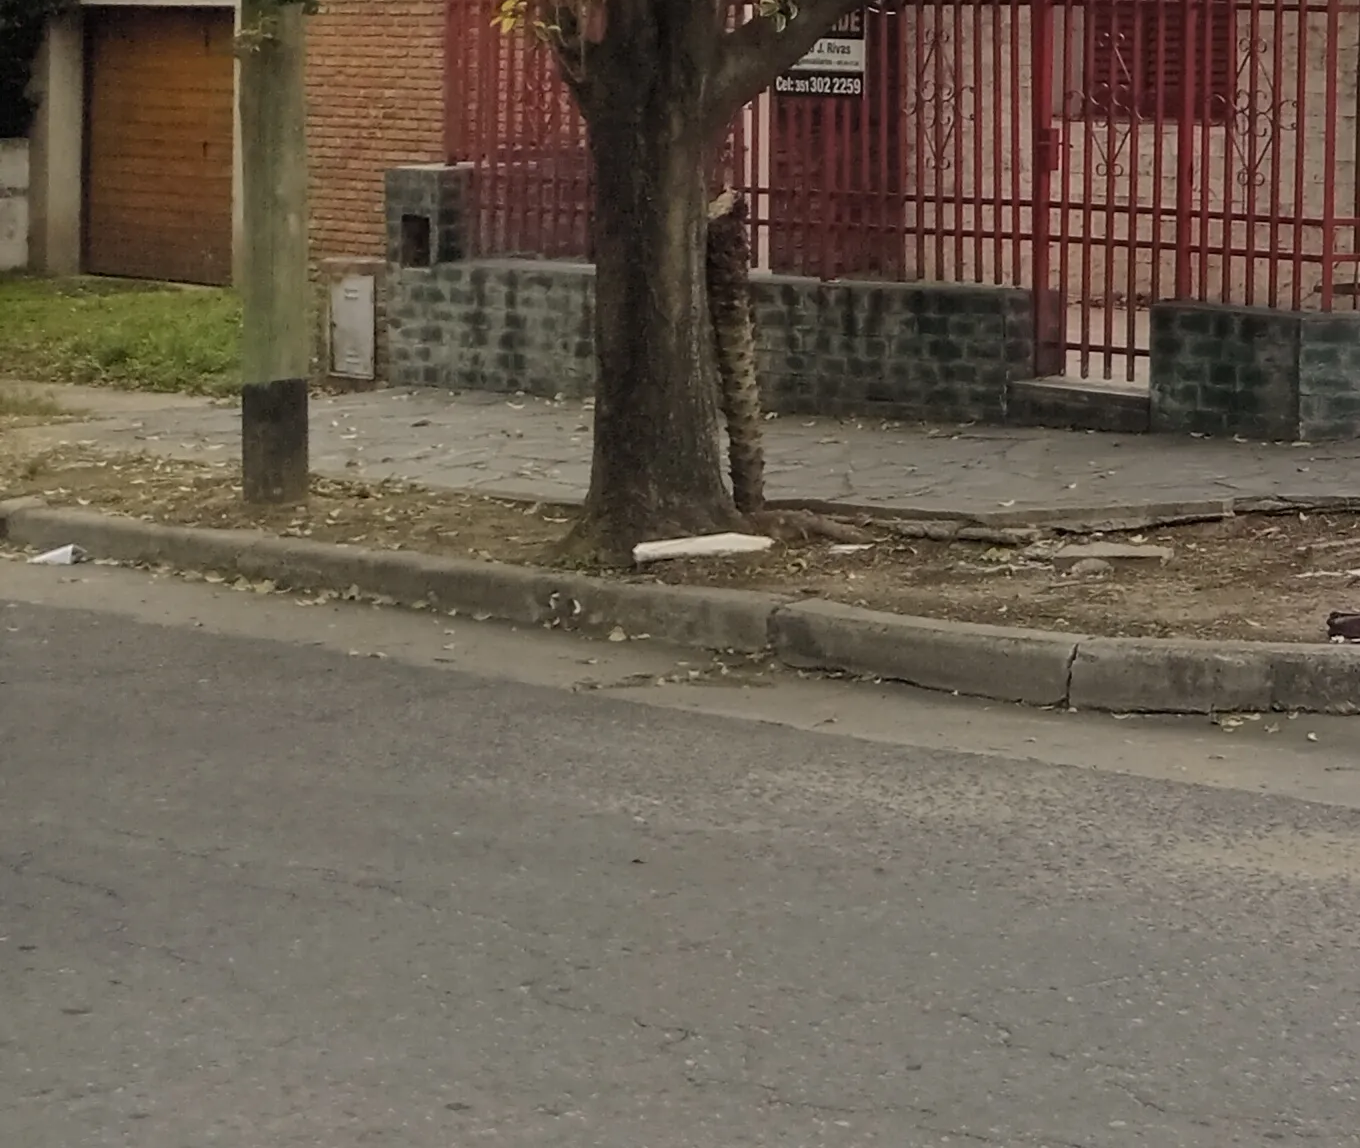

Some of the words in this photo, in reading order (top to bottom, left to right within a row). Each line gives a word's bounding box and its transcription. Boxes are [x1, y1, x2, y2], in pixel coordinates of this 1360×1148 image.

[776, 76, 793, 92] Cel:
[810, 77, 831, 93] 302
[832, 78, 861, 94] 2259
